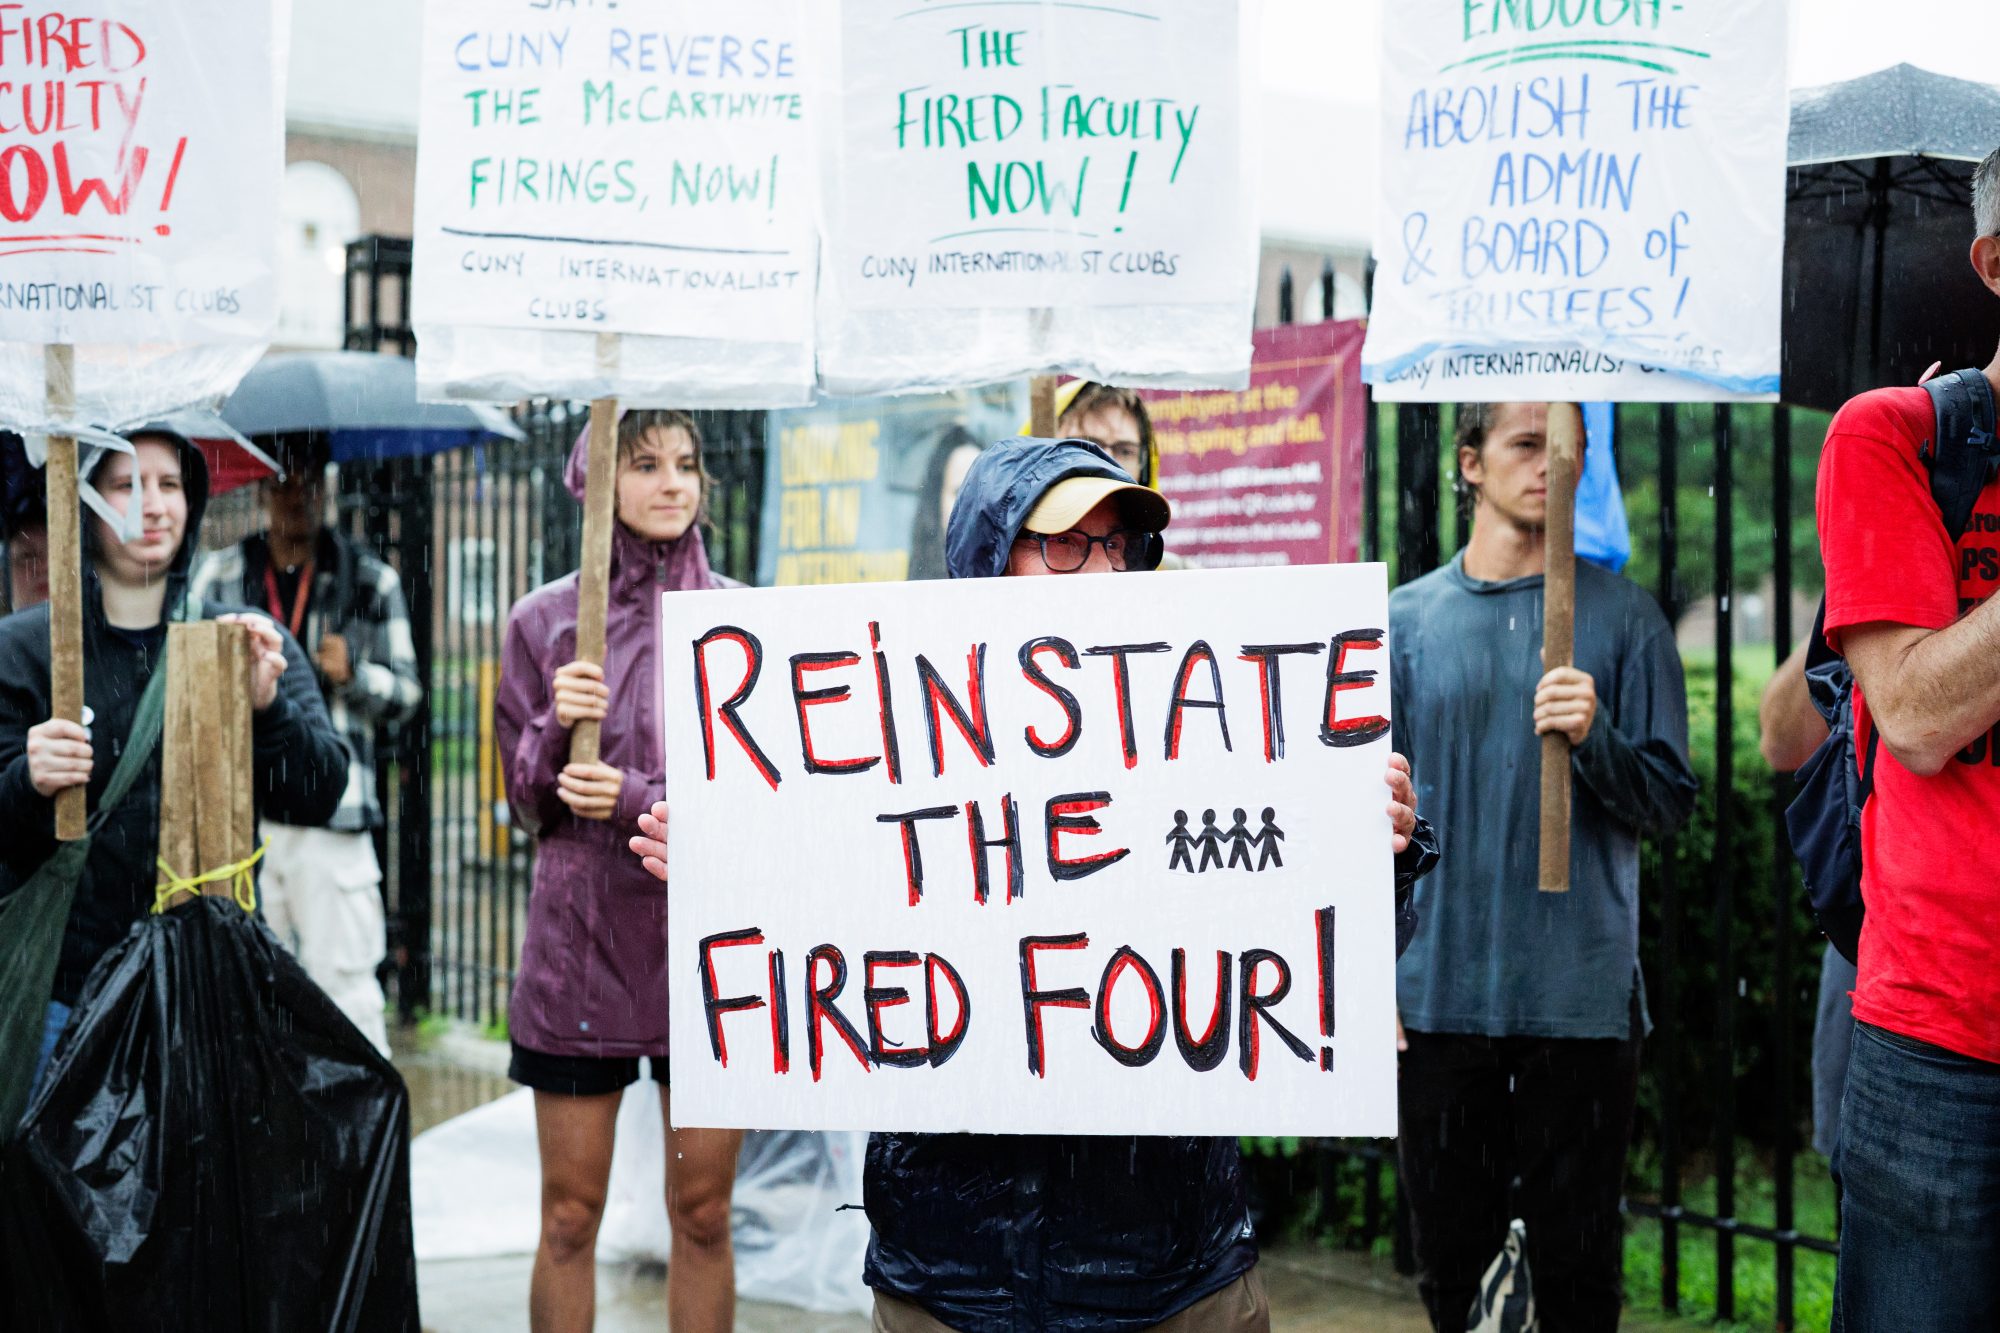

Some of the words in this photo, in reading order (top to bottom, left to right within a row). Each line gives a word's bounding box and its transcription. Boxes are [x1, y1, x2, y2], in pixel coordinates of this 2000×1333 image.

[0, 4, 146, 73] FIRED
[456, 27, 570, 72] CUNY
[610, 29, 795, 79] REVERSE
[946, 24, 1028, 69] THE
[464, 88, 541, 127] THE
[893, 85, 1023, 149] FIRED
[1040, 85, 1199, 184] FACULTY
[1404, 73, 1590, 149] ABOLISH
[1616, 79, 1700, 132] THE
[470, 157, 648, 211] FIRINGS,
[671, 154, 778, 224] NOW!
[1490, 148, 1641, 212] ADMIN
[461, 251, 525, 277] CUNY
[560, 256, 801, 290] INTERNATIONALIST
[862, 255, 918, 287] CUNY
[928, 251, 1103, 275] INTERNATIONALST
[1109, 251, 1181, 277] CLUBS
[1402, 212, 1436, 285] &
[1462, 214, 1610, 279] BOARD
[175, 286, 241, 314] CLUBS
[528, 298, 607, 322] CLUBS
[876, 791, 1131, 906] THE
[697, 927, 971, 1082] FIRED
[1018, 906, 1336, 1080] FOUR!
